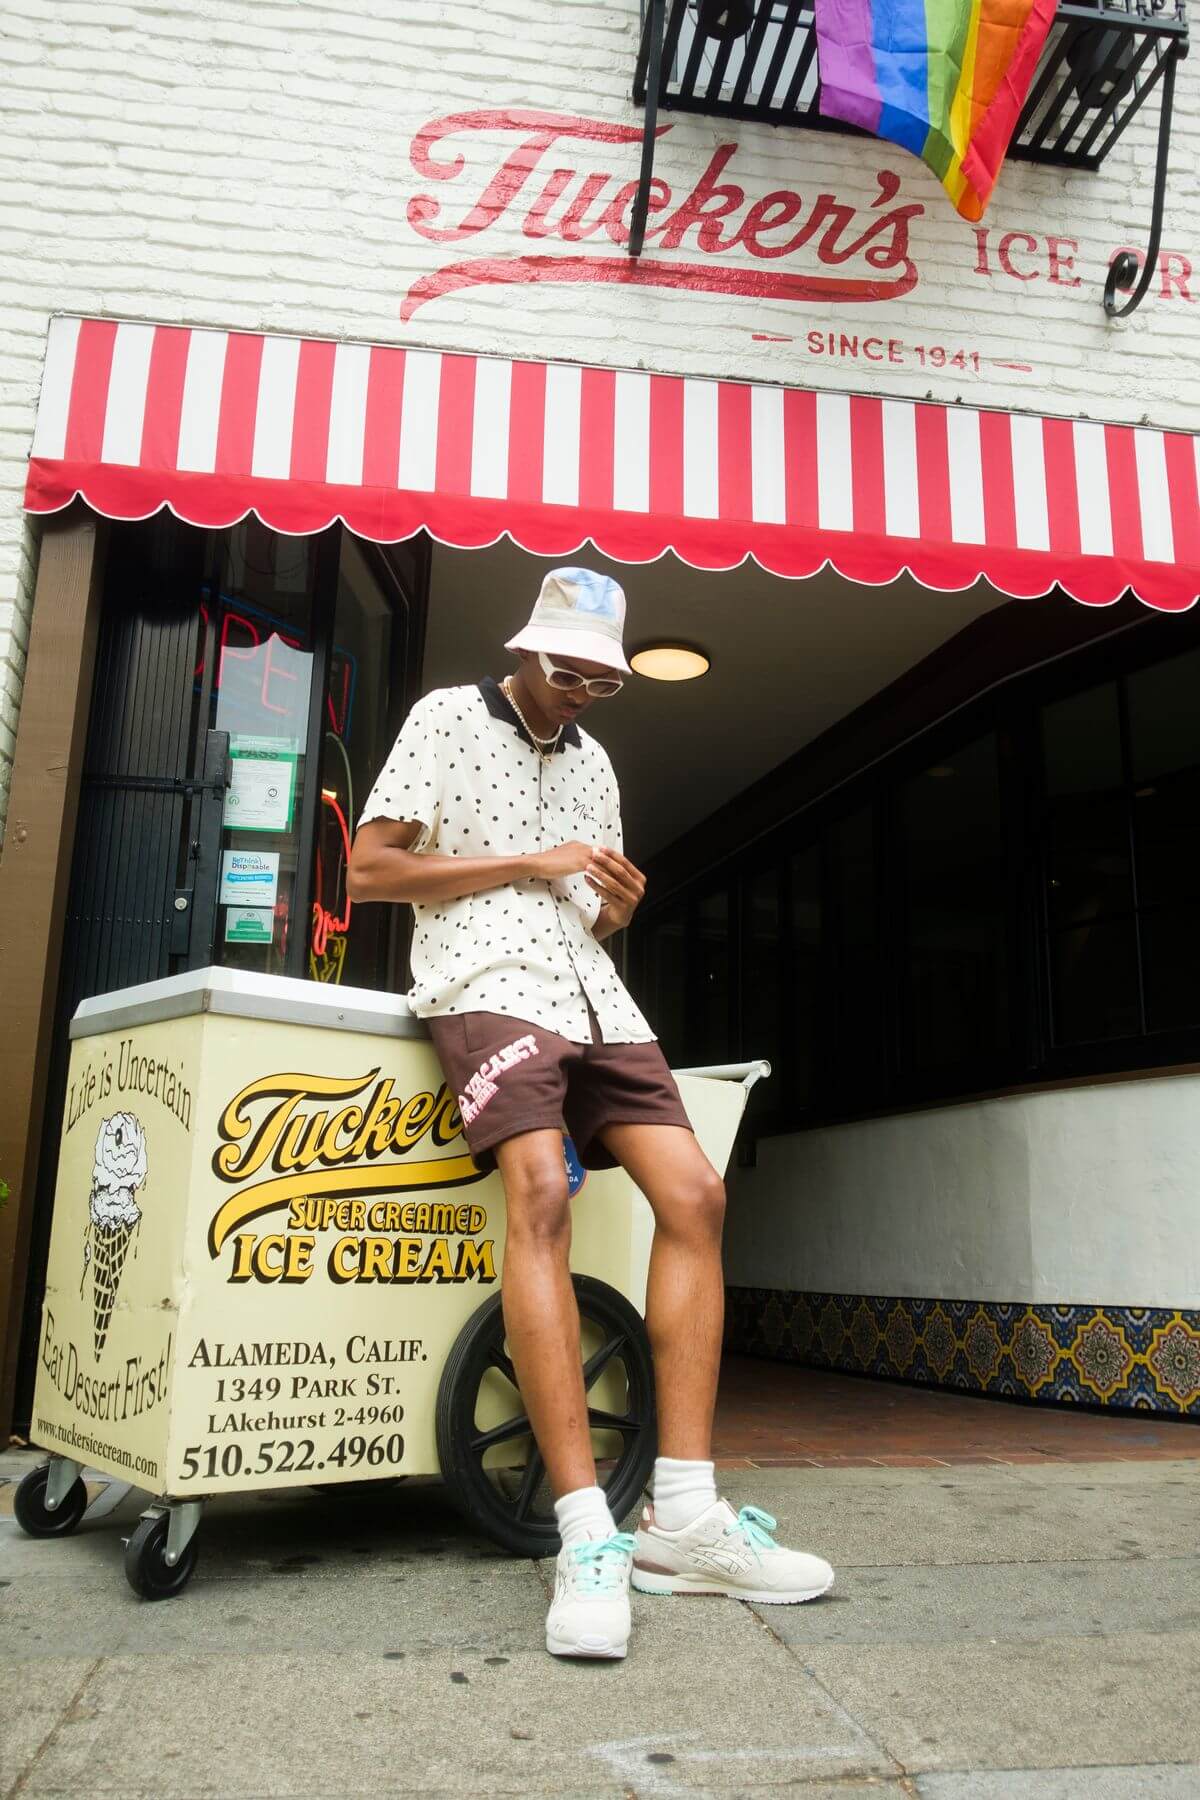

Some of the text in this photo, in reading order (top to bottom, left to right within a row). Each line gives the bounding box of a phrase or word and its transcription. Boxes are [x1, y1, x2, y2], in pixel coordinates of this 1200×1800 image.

[404, 108, 925, 295] Tucker's
[971, 227, 1082, 287] ICE
[807, 331, 980, 372] SINCE 1941
[66, 1039, 192, 1134] Life is Uncertain
[287, 1197, 487, 1235] SUPER CREAMED
[227, 1233, 498, 1284] ICE CREAM
[42, 1308, 172, 1422] Eat Dessert First!
[187, 1337, 336, 1369] ALAMEDA,
[214, 1376, 281, 1402] 1349
[291, 1376, 357, 1399] PARK
[207, 1404, 404, 1433] LAkehurst 2-4960
[36, 1417, 158, 1479] www.tuckersicecream.com
[178, 1433, 405, 1481] 510.522.4960
